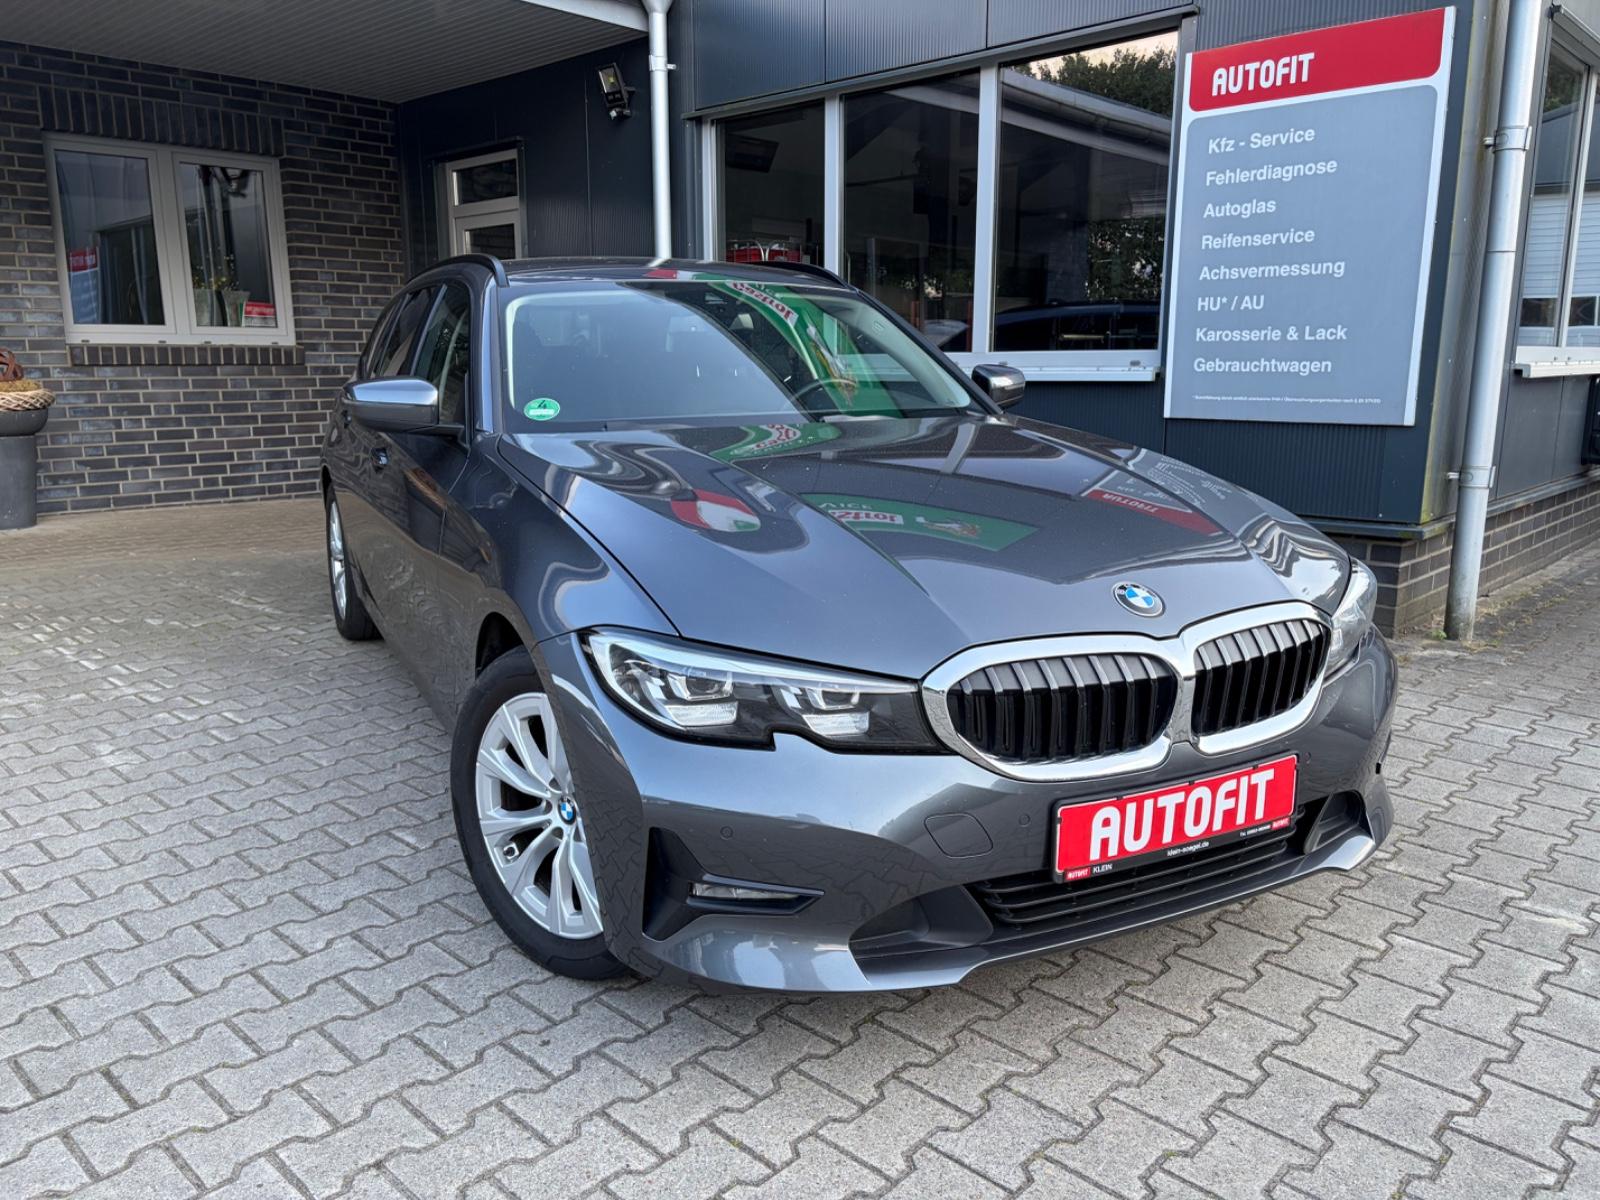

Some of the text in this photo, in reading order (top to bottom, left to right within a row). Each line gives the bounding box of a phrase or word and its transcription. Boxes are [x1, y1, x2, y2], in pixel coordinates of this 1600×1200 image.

[1211, 52, 1315, 97] AUTOFIT
[1208, 138, 1235, 155] Kfz
[1250, 127, 1315, 149] Service
[1205, 160, 1338, 187] Fehlerdiagnose
[1203, 198, 1276, 221] Autoglas
[1201, 228, 1315, 250] Reifenservice
[1199, 260, 1346, 281] Achsvermessung
[1240, 295, 1264, 310] AU
[1195, 324, 1348, 342] Karosserie & Lack
[1193, 357, 1333, 376] Gebrauchtwagen
[1089, 768, 1275, 861] AUTOFIT
